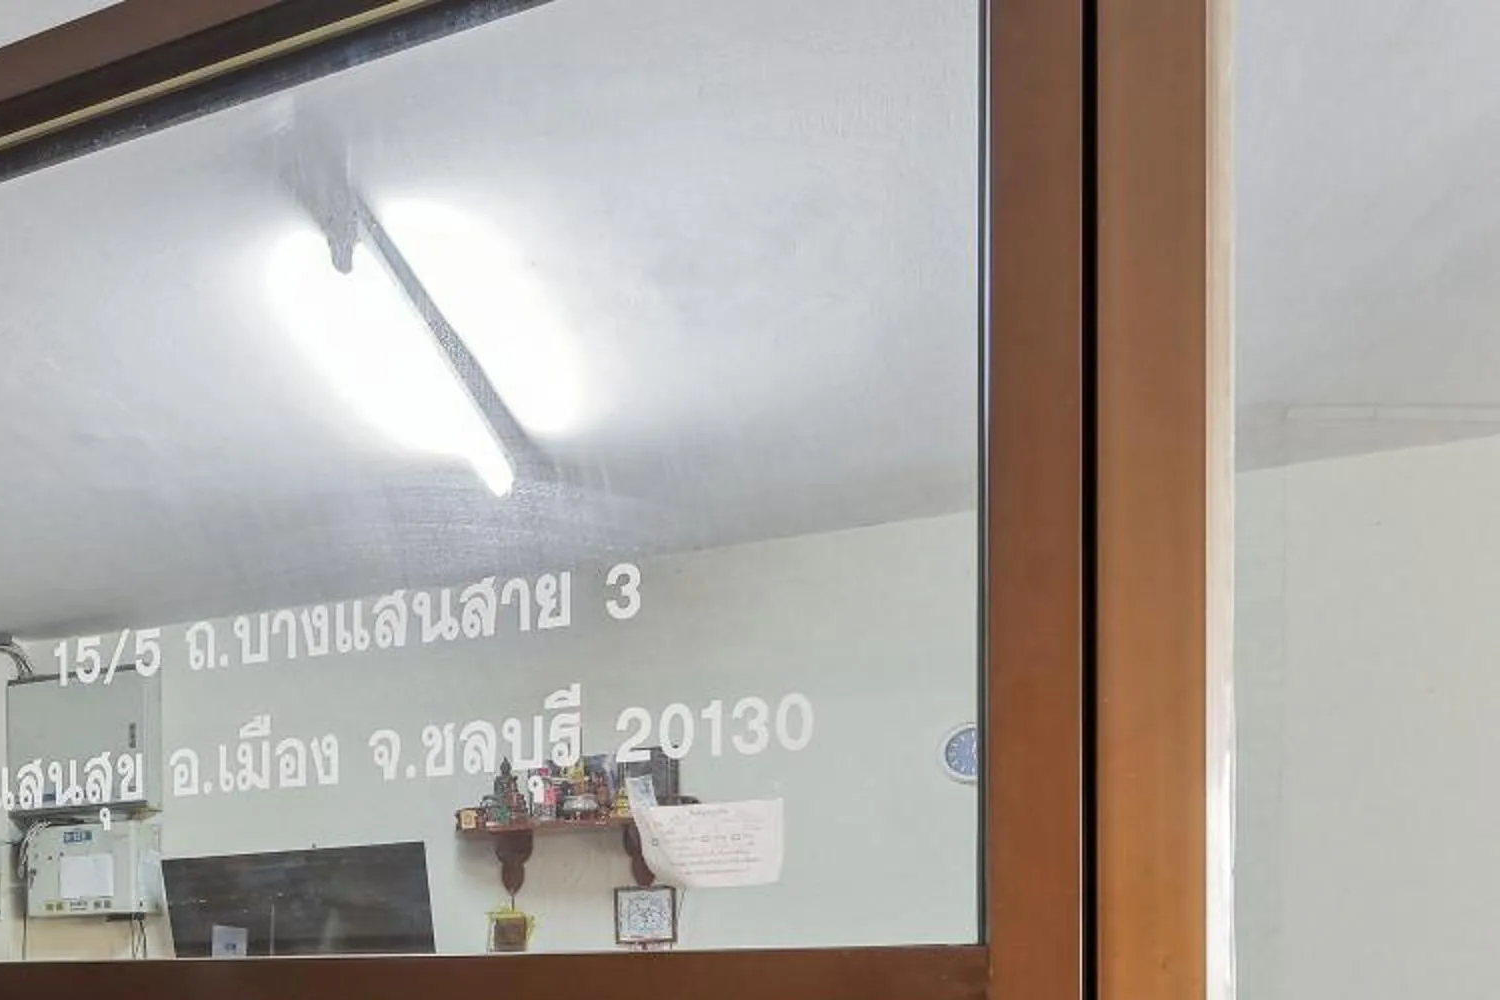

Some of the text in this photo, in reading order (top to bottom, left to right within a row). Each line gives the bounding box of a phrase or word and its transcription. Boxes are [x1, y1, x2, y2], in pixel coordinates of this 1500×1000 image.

[54, 562, 641, 686] 15/5 ถ.บางแสนสาย 3
[170, 716, 339, 797] อ.เมือง
[369, 683, 582, 806] จ.ชลบุรี
[616, 693, 814, 763] 20130
